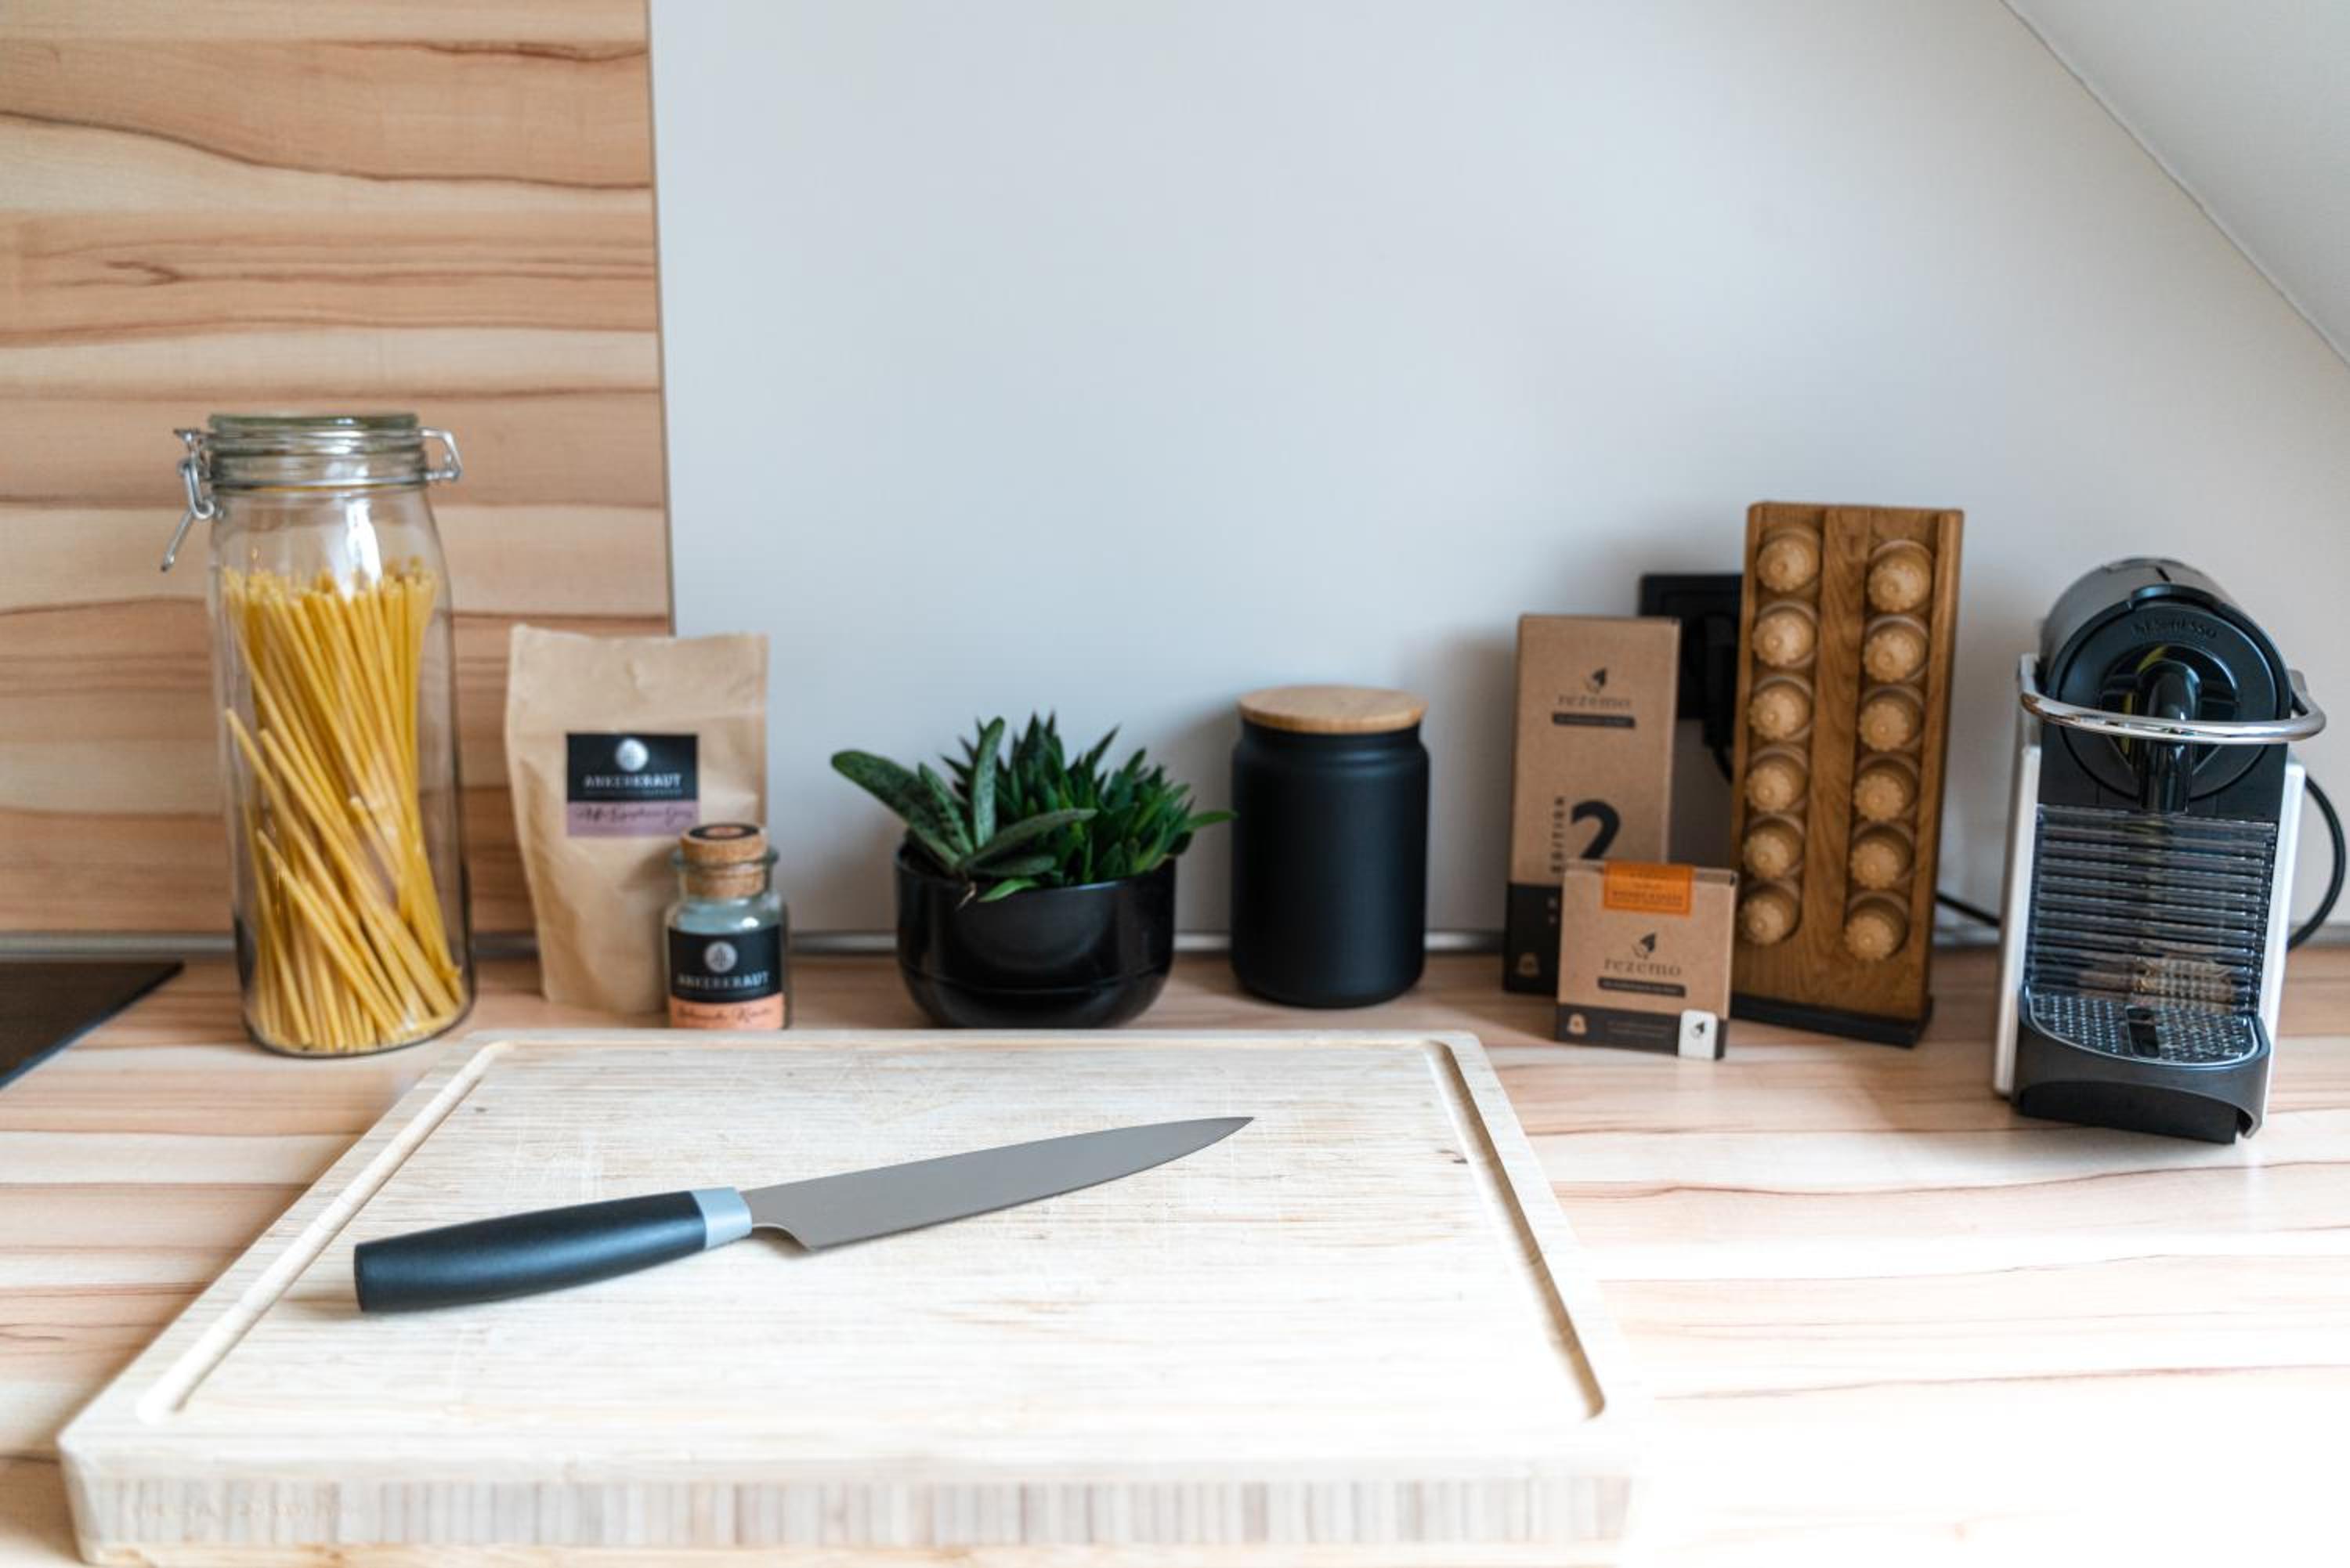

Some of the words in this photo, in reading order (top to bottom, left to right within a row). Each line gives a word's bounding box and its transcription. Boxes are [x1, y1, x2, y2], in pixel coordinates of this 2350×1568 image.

[1557, 694, 1631, 709] rezemo
[584, 772, 683, 789] ANKERKRAUT
[1571, 800, 1621, 860] 2
[1603, 958, 1683, 977] rezemo
[676, 970, 768, 988] ANKERKRAUT
